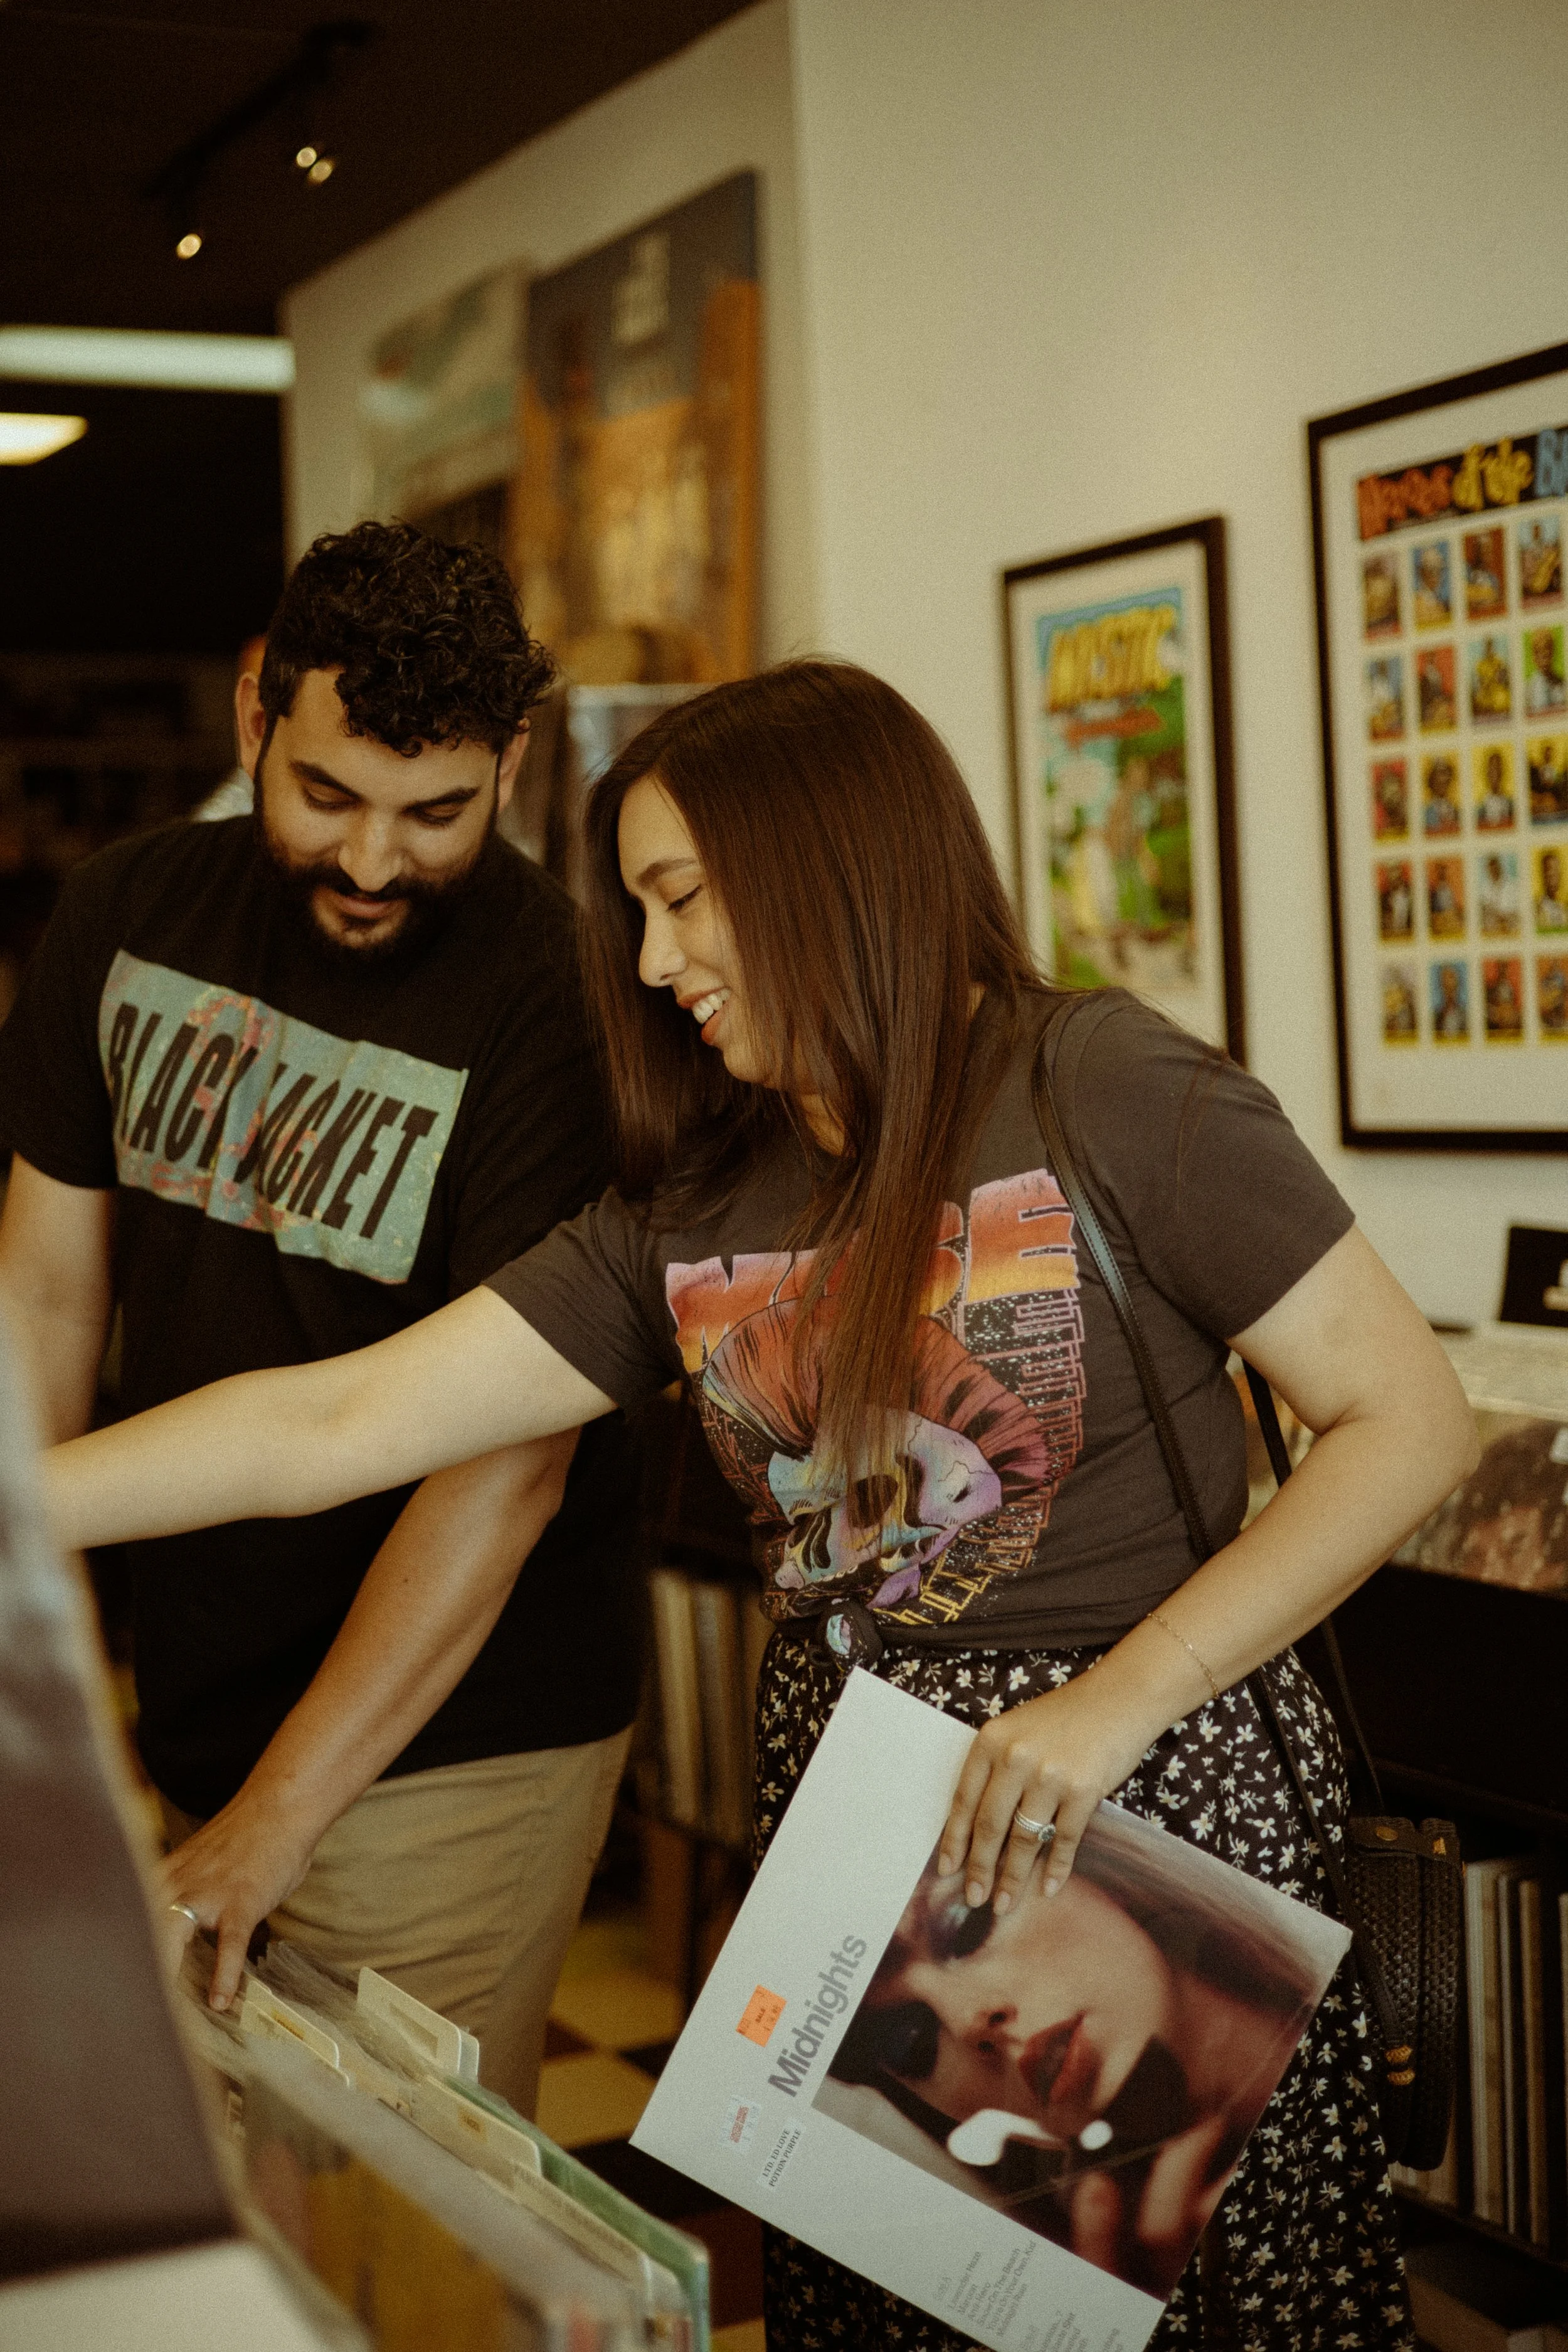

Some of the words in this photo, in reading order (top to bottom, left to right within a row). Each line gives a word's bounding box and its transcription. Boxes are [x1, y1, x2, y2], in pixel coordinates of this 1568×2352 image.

[768, 1935, 867, 2097] Midnights
[762, 2161, 775, 2177] LTD.
[771, 2148, 780, 2160] ED
[776, 2129, 790, 2149] LOVE
[768, 2159, 787, 2187] POTION
[783, 2129, 801, 2158] PURPLE
[967, 2252, 982, 2272] Haze
[1002, 2248, 1020, 2274] Beach
